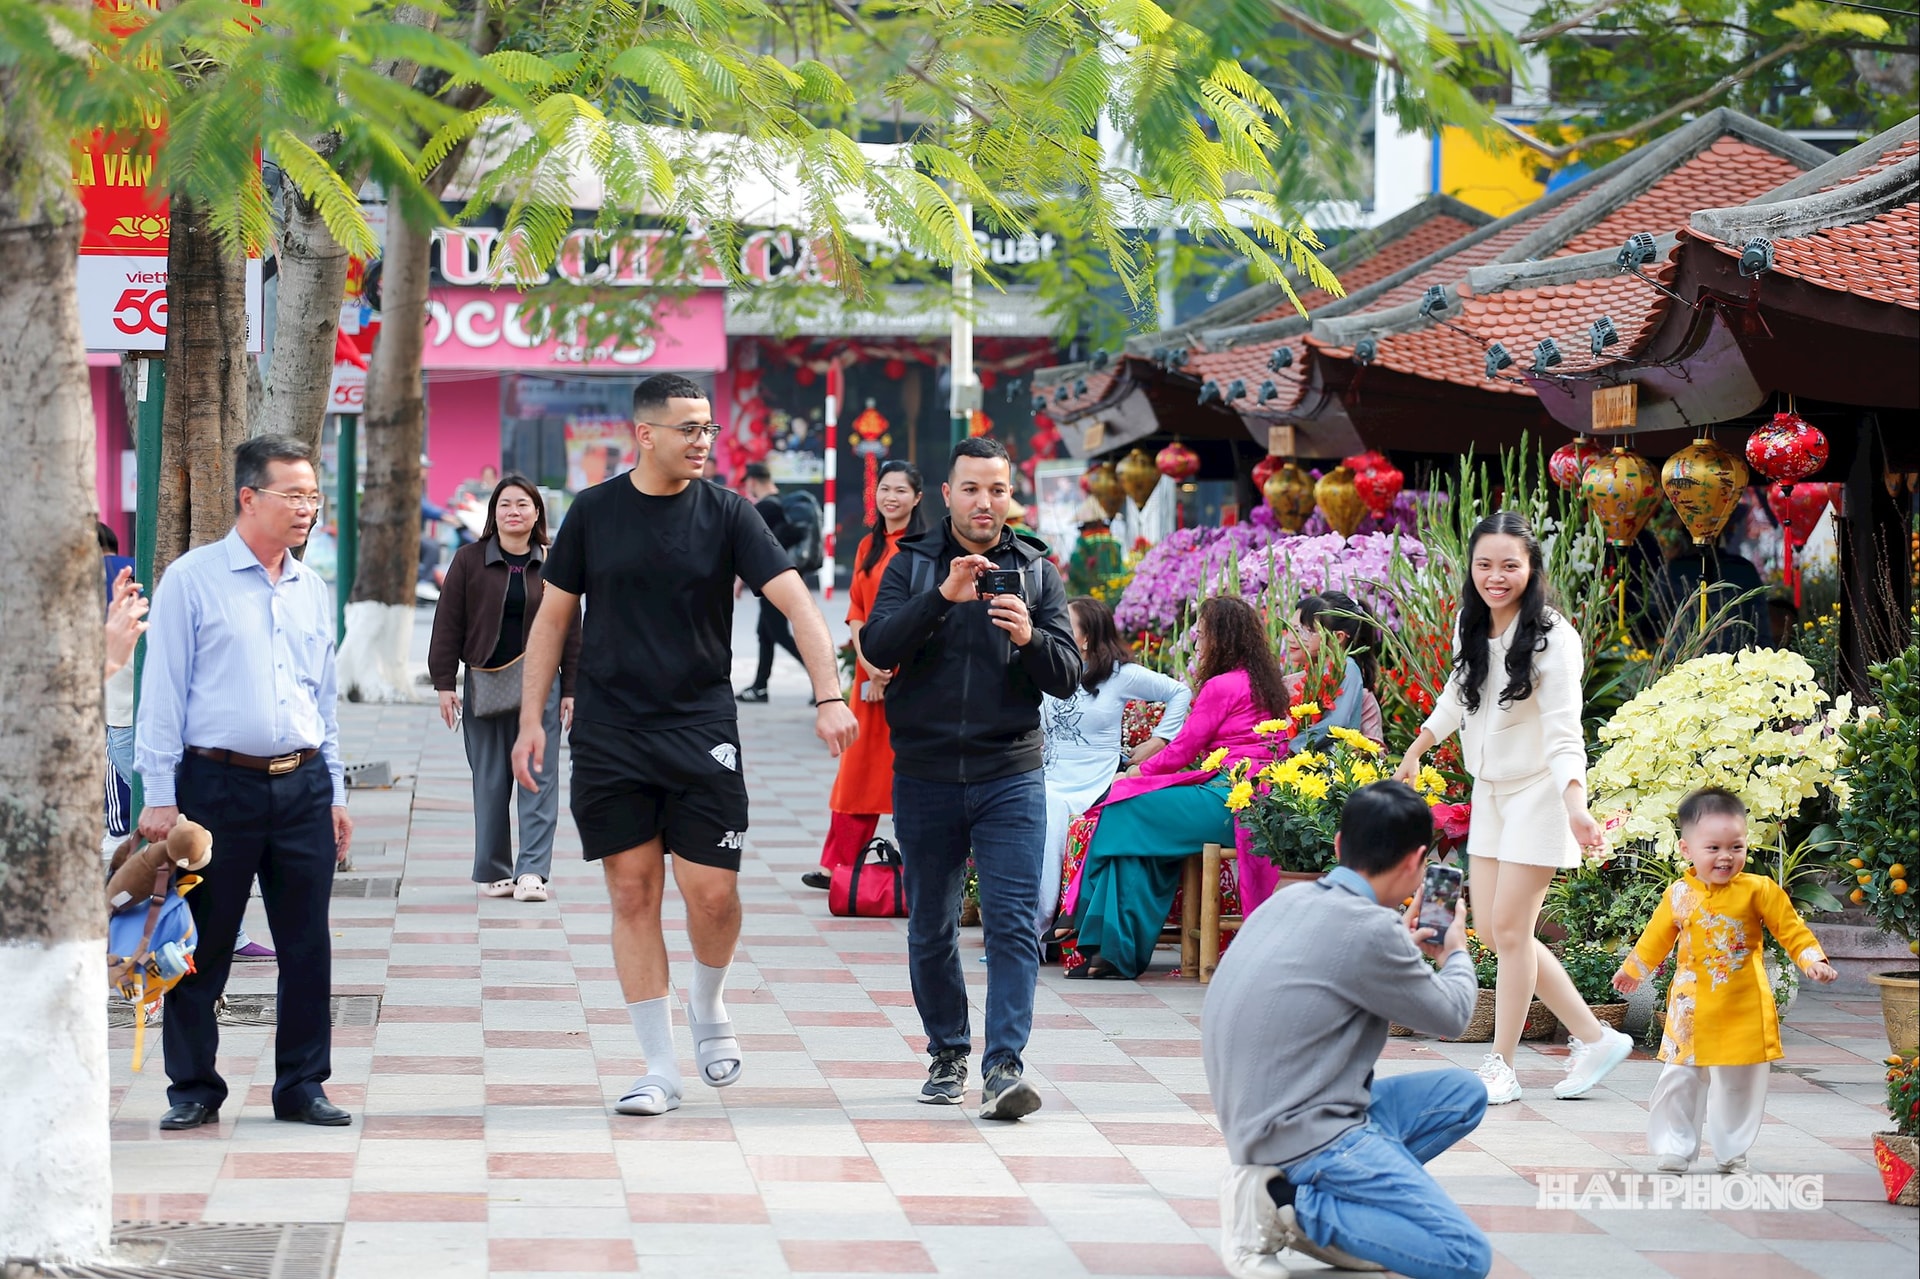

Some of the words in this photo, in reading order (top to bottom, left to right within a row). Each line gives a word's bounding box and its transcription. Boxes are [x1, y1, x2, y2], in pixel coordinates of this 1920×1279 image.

[103, 147, 152, 187] VĂN
[126, 271, 168, 283] viett
[431, 226, 549, 285] UA
[113, 289, 168, 335] 5G
